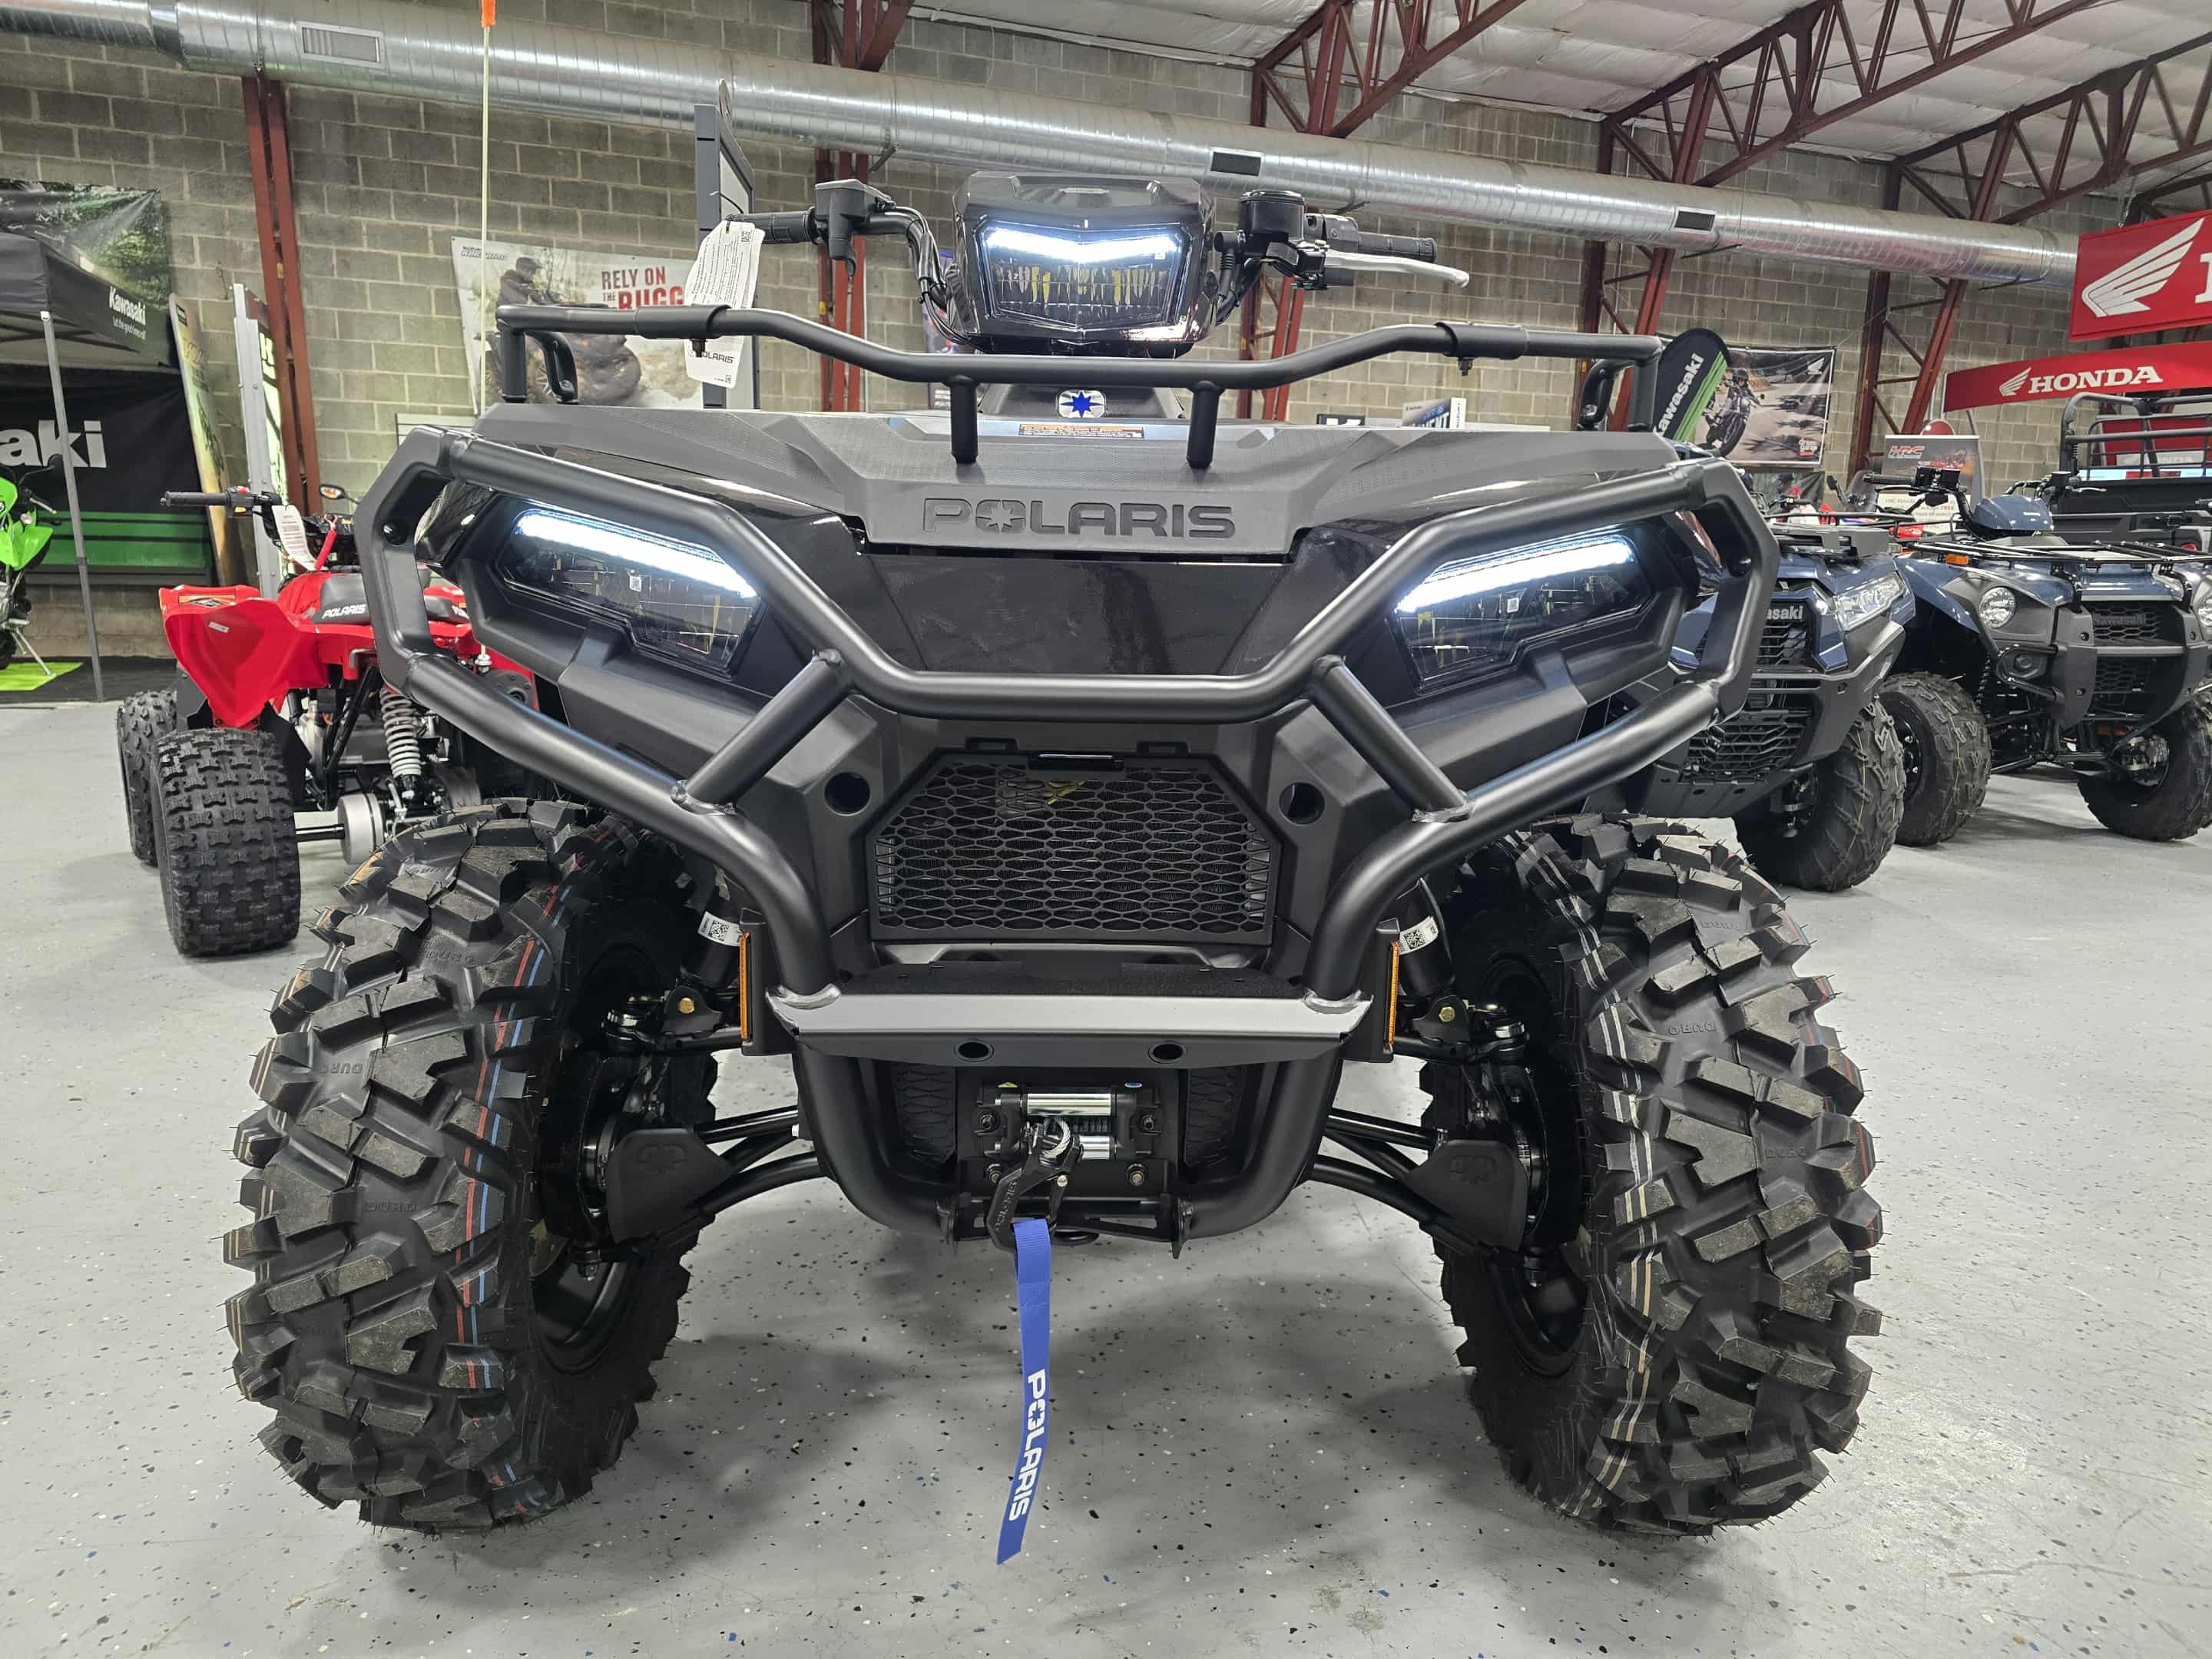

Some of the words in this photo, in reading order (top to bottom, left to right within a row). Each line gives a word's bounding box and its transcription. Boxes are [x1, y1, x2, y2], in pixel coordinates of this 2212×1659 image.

[602, 268, 637, 290] RELY
[645, 266, 666, 286] ON
[109, 286, 146, 326] Kawasaki
[602, 291, 616, 302] THE
[701, 351, 735, 364] OLARIS
[2028, 366, 2163, 394] HONDA
[923, 498, 1235, 538] POLARIS
[322, 604, 367, 619] POLARIS
[1008, 1369, 1046, 1521] POLARIS
